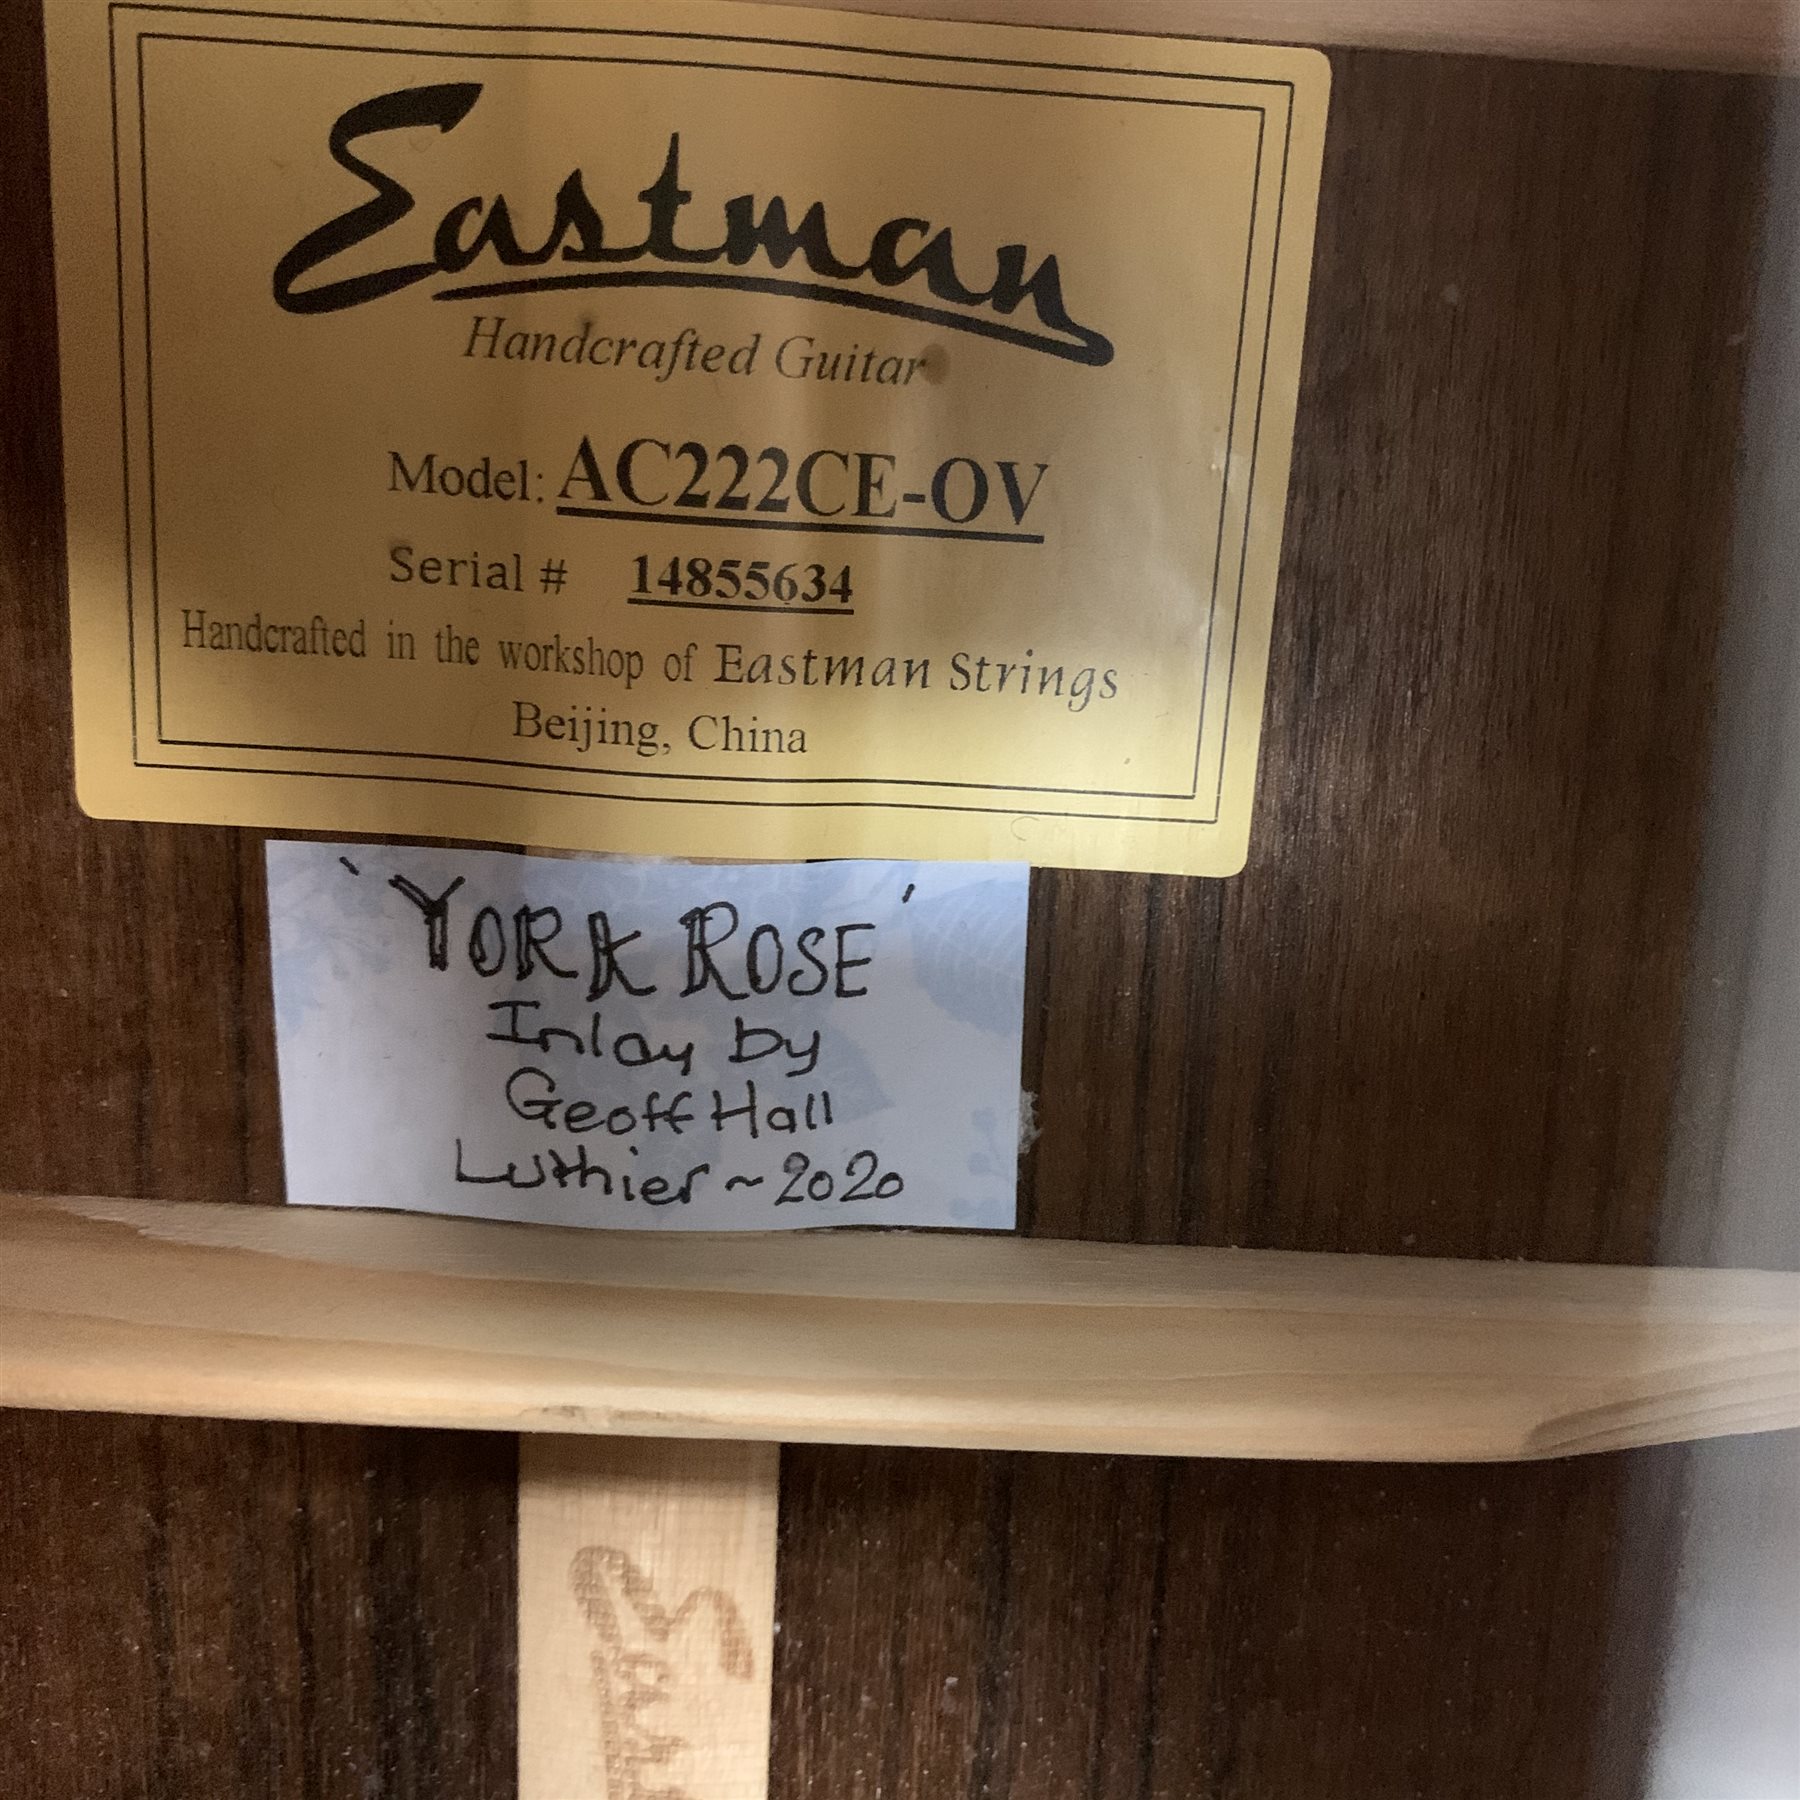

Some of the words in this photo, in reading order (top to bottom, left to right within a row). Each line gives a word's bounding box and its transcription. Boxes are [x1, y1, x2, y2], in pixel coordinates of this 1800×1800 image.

[273, 81, 1115, 367] Eastman
[462, 315, 763, 381] Handcrafted
[775, 335, 927, 387] Guitar
[387, 450, 544, 505] Model:
[554, 434, 1049, 530] AC222CE-OV
[389, 546, 525, 593] Serial
[627, 553, 855, 608] 14855634
[181, 608, 367, 660] Handcrafted
[386, 618, 416, 662] in
[434, 625, 480, 667] the
[497, 633, 644, 686] workshop
[663, 640, 699, 683] of
[712, 643, 931, 690] Eastman
[949, 648, 1117, 706] Strings
[510, 700, 672, 758] Beijing,
[687, 713, 808, 755] China
[486, 1000, 695, 1076] Inlay
[727, 1015, 821, 1077] by
[504, 1066, 695, 1134] Geoff
[711, 1080, 834, 1136] Hall
[455, 1138, 711, 1205] Luthier
[773, 1150, 905, 1205] 2020
